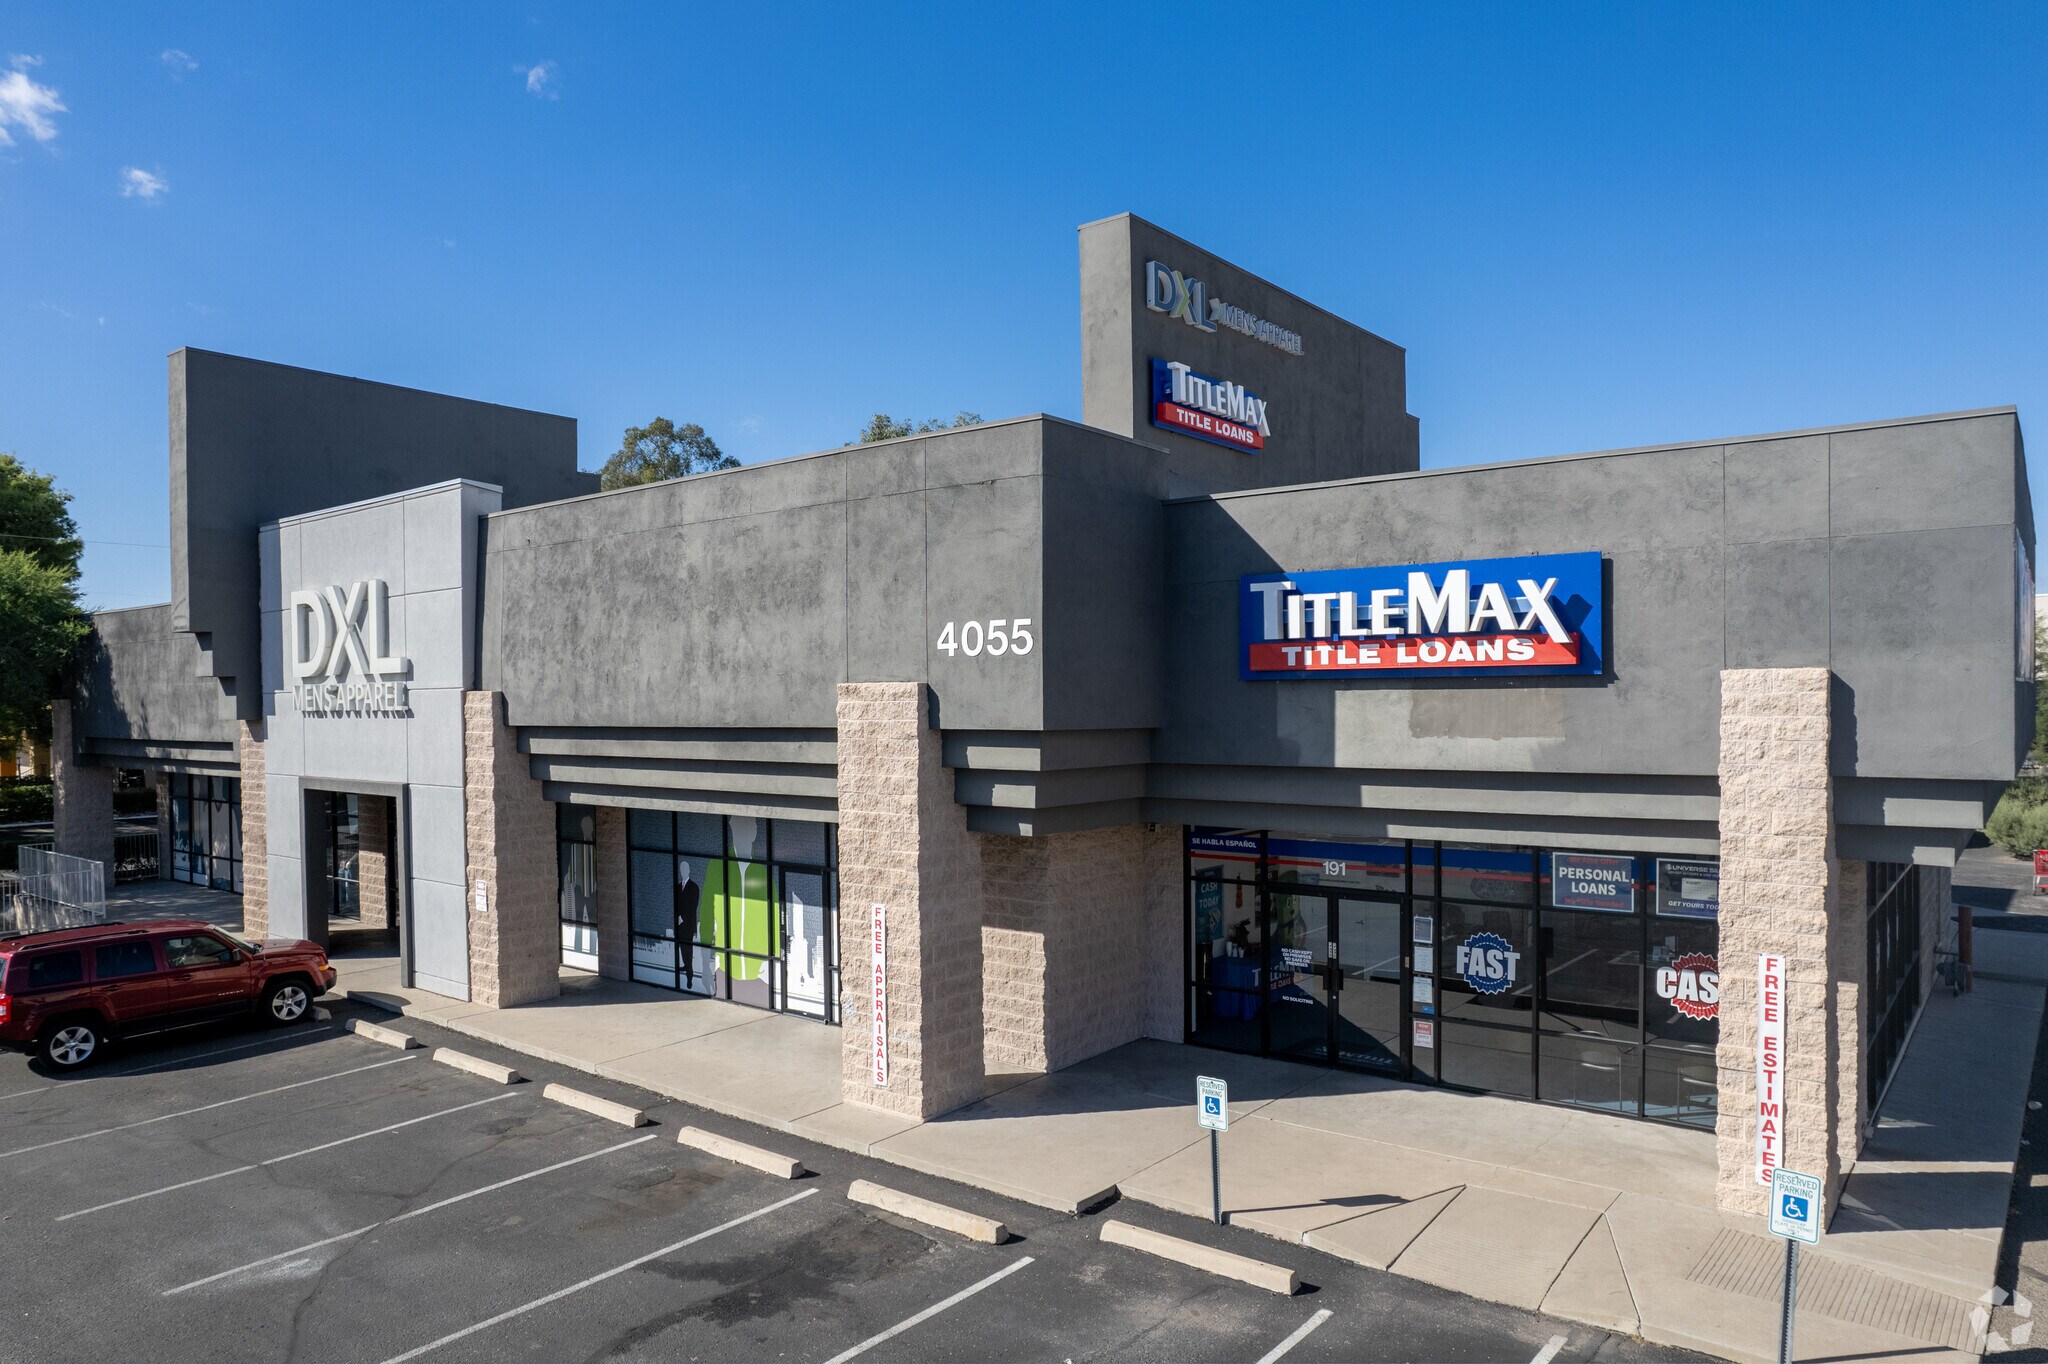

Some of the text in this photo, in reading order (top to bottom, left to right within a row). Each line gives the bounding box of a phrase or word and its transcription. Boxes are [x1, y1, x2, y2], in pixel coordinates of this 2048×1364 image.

[1146, 260, 1217, 333] DXL
[1219, 303, 1305, 356] MENS APPAREL
[1167, 361, 1271, 437] TITLEMAX
[1176, 408, 1254, 443] TITLE LOANS
[1250, 569, 1573, 643] TITLEMAX
[290, 579, 408, 678] DXL
[936, 618, 1034, 657] 4055
[1281, 638, 1535, 666] TITLE LOANS
[292, 681, 409, 711] MENS APPAREL
[1322, 861, 1347, 876] 191
[1559, 866, 1630, 882] PERSONAL
[1199, 896, 1219, 908] TODAY
[1201, 882, 1217, 893] CASH
[1571, 881, 1617, 896] LOANS
[1682, 901, 1705, 909] YOURS
[1456, 945, 1521, 981] FAST
[874, 907, 884, 1083] FREE APPRAISALS
[1760, 957, 1779, 1183] FREE ESTIMATES
[1200, 1081, 1224, 1091] RESERVED
[1777, 1174, 1817, 1190] RESERVED
[1780, 1184, 1813, 1198] PARKING
